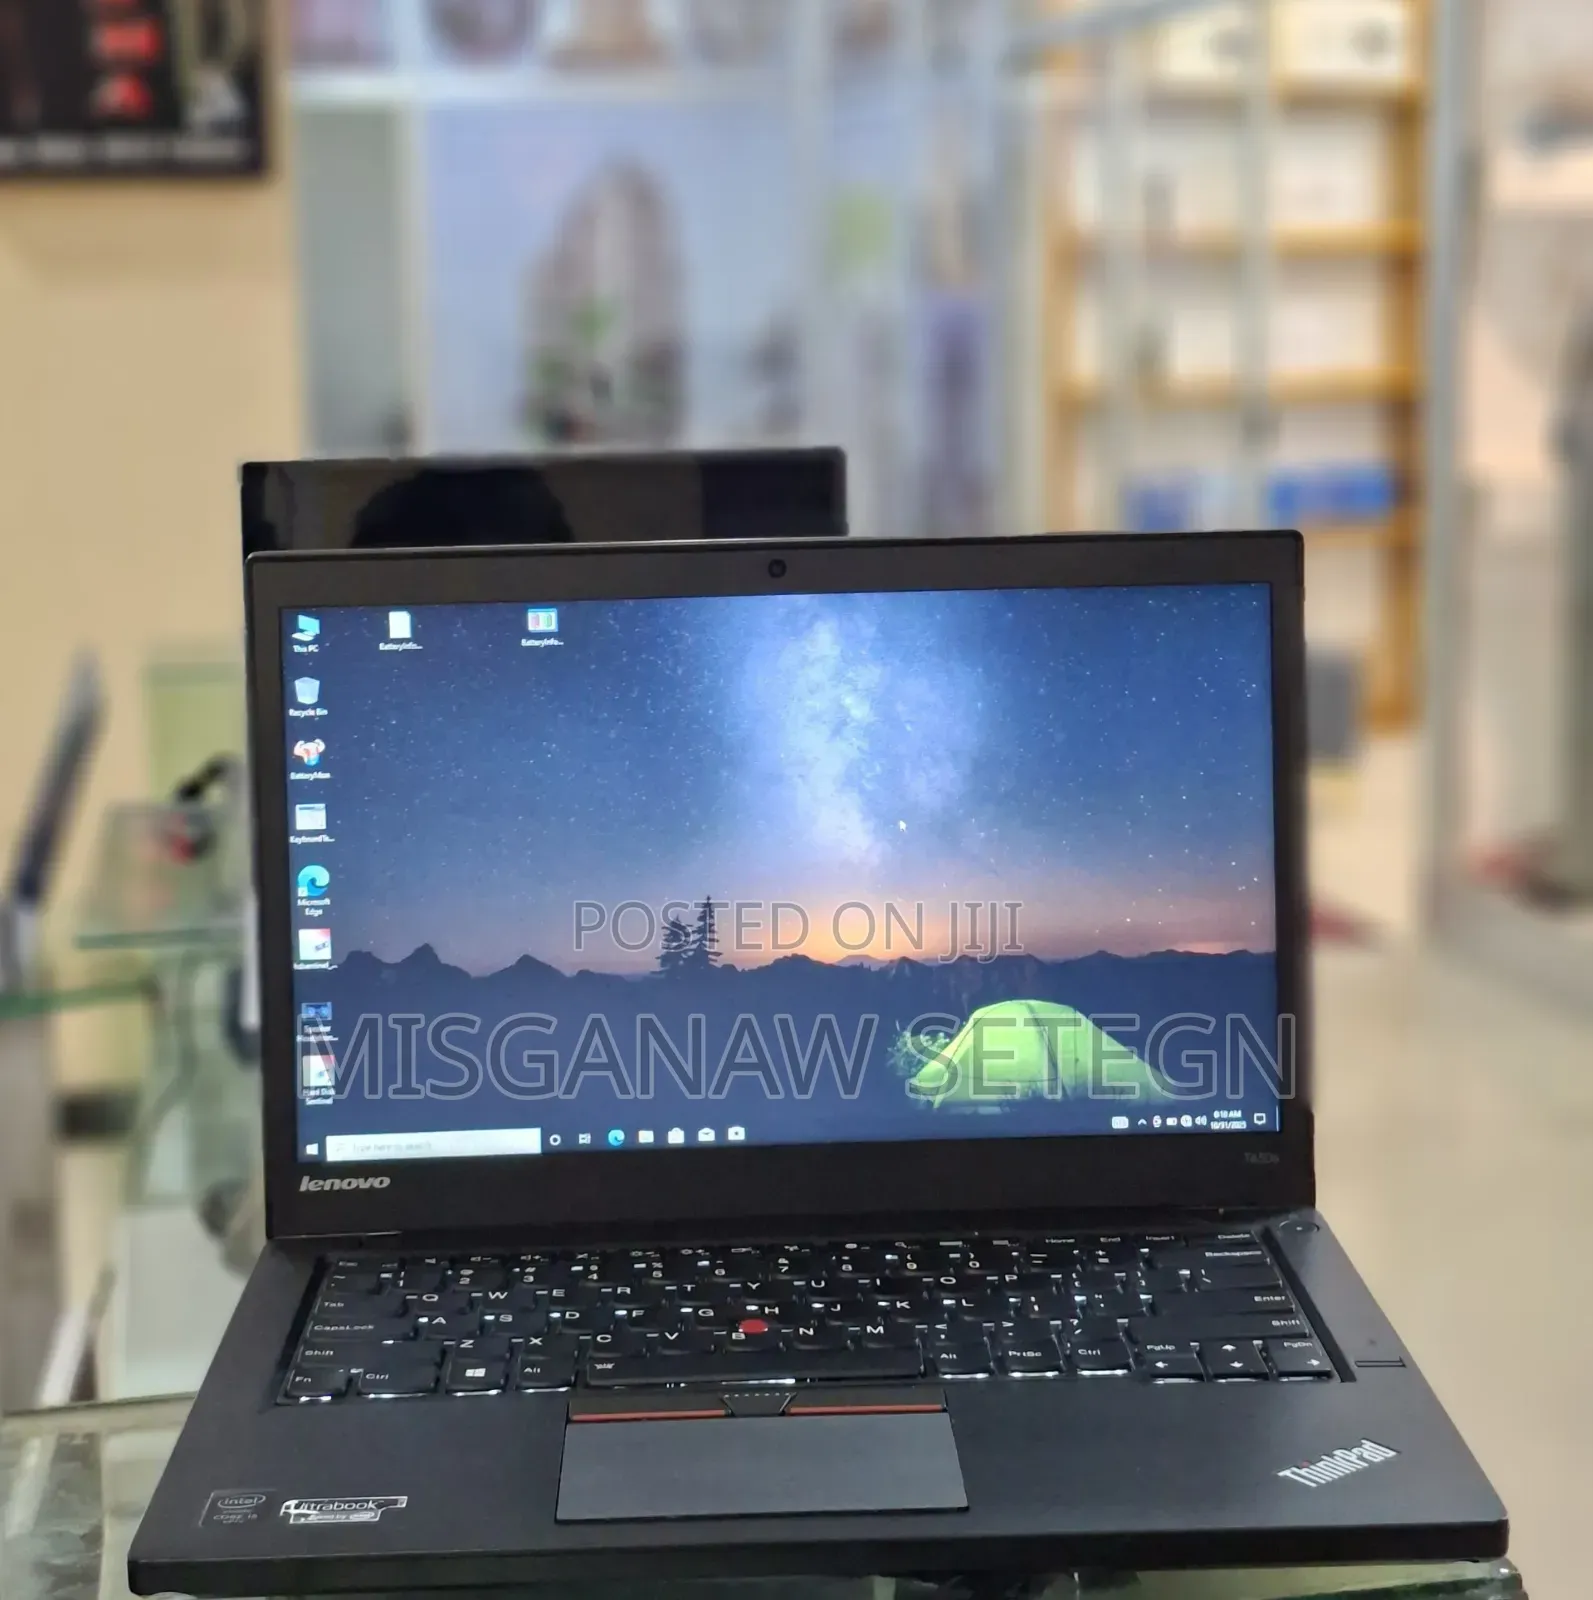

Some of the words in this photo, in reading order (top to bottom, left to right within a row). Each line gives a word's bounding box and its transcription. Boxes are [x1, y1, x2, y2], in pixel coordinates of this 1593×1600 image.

[308, 644, 320, 653] PC
[288, 707, 315, 717] Recycle
[316, 707, 329, 716] Bin
[297, 898, 331, 906] Microsoft
[305, 907, 323, 917] Edge
[1228, 1109, 1242, 1118] AM
[299, 1175, 391, 1192] lenovo
[778, 1265, 790, 1273] 7
[459, 1277, 471, 1285] 2
[523, 1275, 535, 1283] 3
[587, 1273, 599, 1281] 4
[939, 1276, 957, 1285] O
[1004, 1274, 1018, 1282] P
[683, 1284, 696, 1292] T
[747, 1281, 761, 1290] Y
[811, 1279, 825, 1288] U
[552, 1288, 566, 1297] E
[616, 1286, 631, 1294] R
[422, 1293, 439, 1302] Q
[488, 1291, 508, 1300] W
[1253, 1294, 1286, 1302] Enter
[896, 1300, 911, 1309] K
[961, 1298, 975, 1307] L
[764, 1306, 780, 1315] H
[830, 1303, 841, 1312] J
[565, 1311, 580, 1320] D
[632, 1310, 645, 1318] F
[698, 1308, 715, 1317] G
[432, 1316, 447, 1325] A
[499, 1314, 514, 1323] S
[1271, 1318, 1300, 1327] Shift
[799, 1327, 814, 1336] N
[866, 1325, 885, 1334] M
[596, 1334, 613, 1343] C
[664, 1331, 679, 1340] V
[731, 1332, 746, 1340] B
[459, 1339, 475, 1349] Z
[529, 1337, 544, 1346] X
[304, 1348, 334, 1357] Shift
[940, 1352, 958, 1360] Alt
[1077, 1348, 1102, 1356] Ctrl
[295, 1375, 312, 1383] Fn
[365, 1372, 389, 1381] Ctrl
[1276, 1437, 1398, 1488] ThinkPad
[224, 1495, 259, 1506] intel
